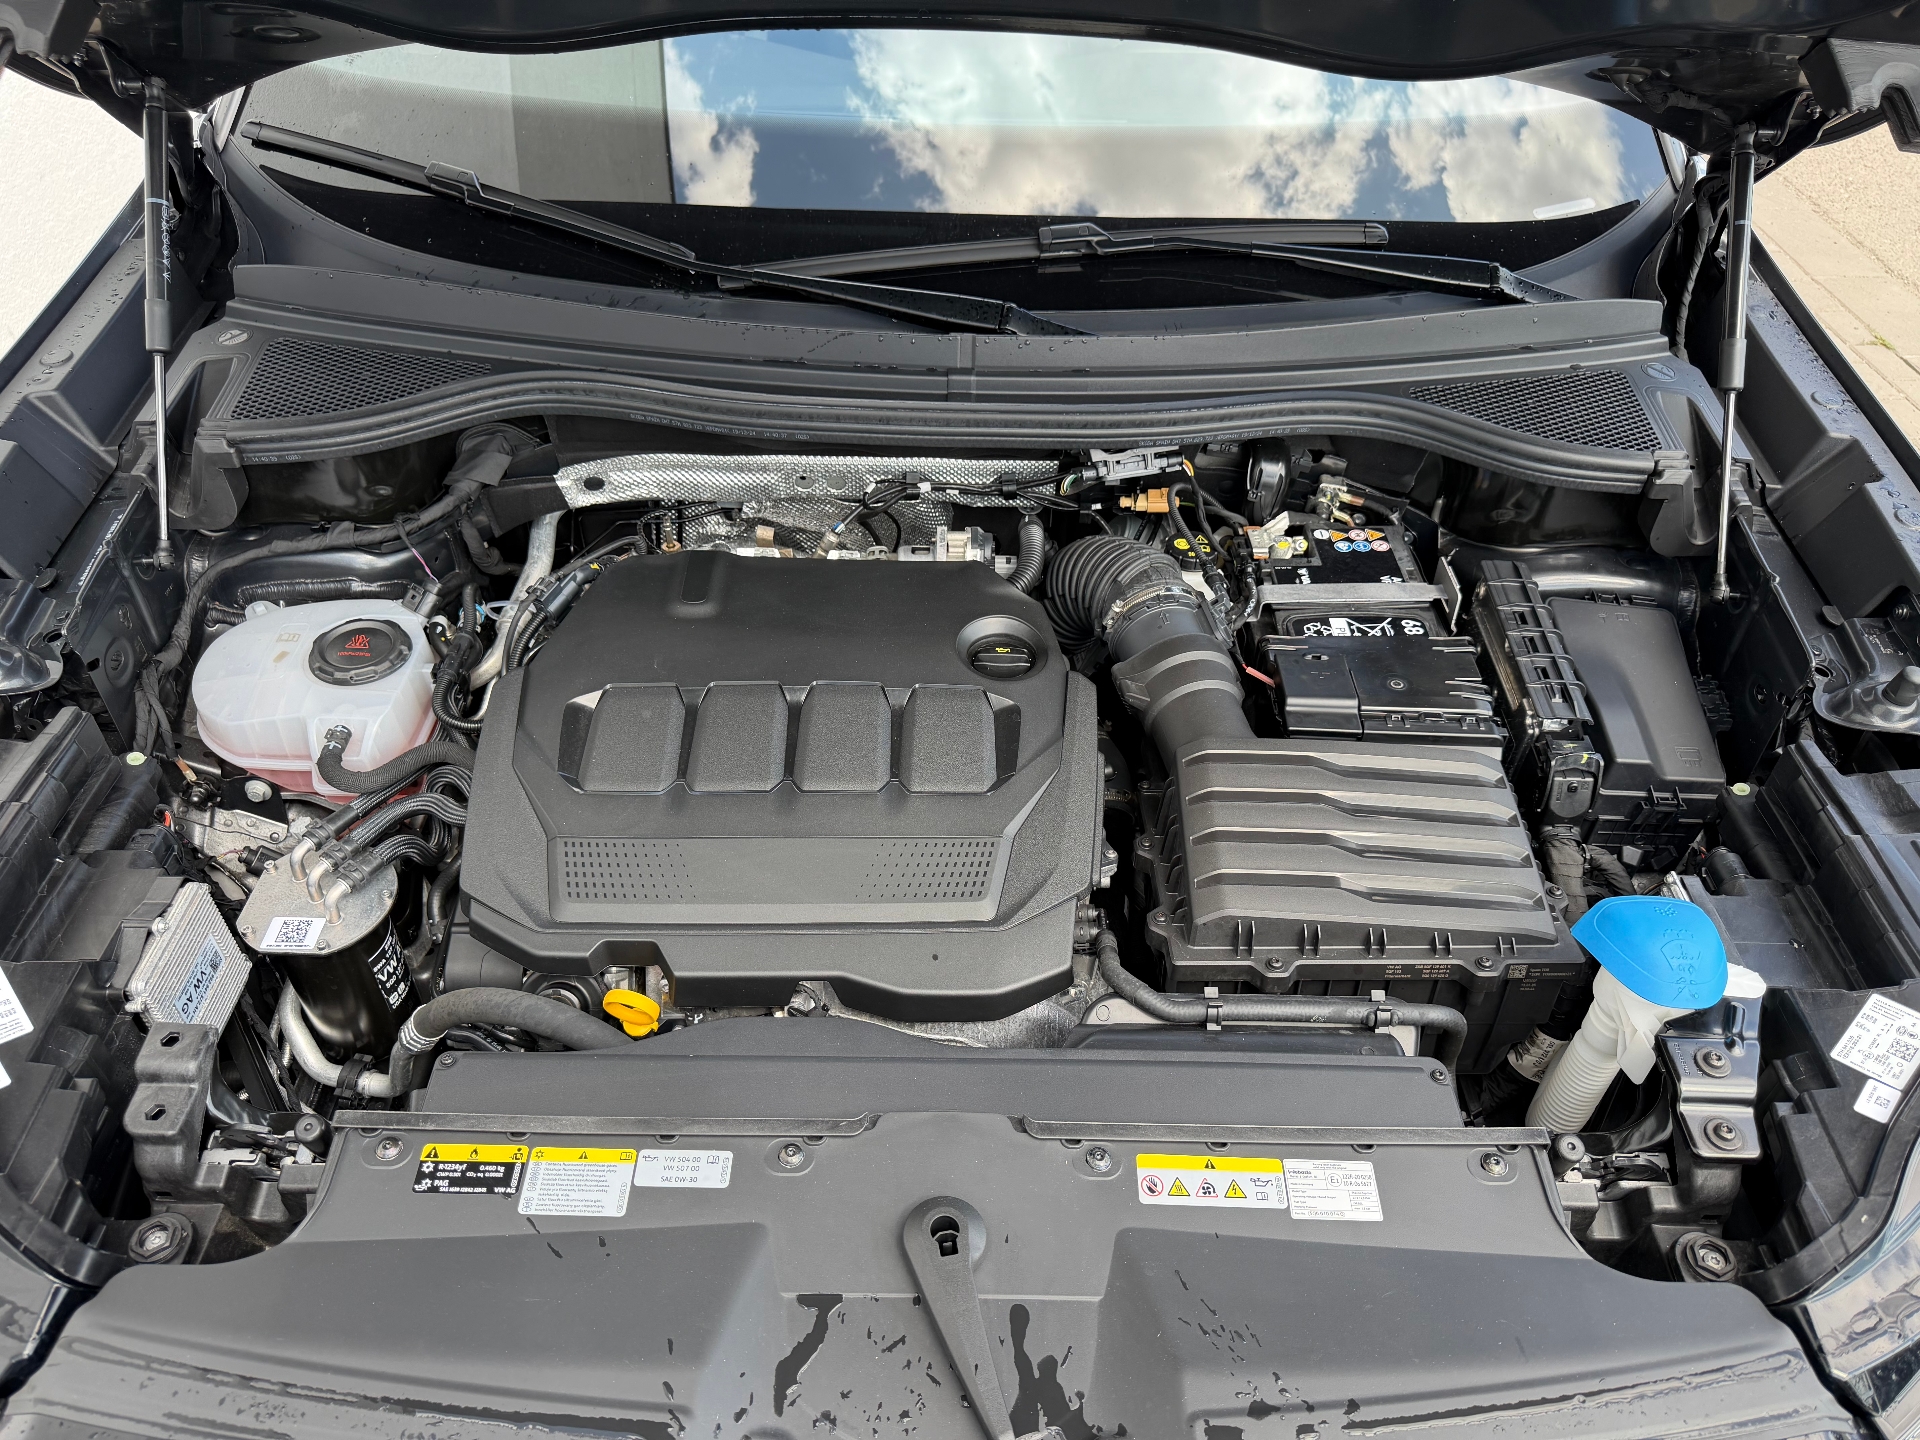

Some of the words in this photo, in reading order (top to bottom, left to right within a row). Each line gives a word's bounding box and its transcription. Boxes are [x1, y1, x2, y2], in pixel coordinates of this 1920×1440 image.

[378, 954, 397, 982] VW
[194, 970, 207, 994] VW
[182, 992, 194, 1014] AG
